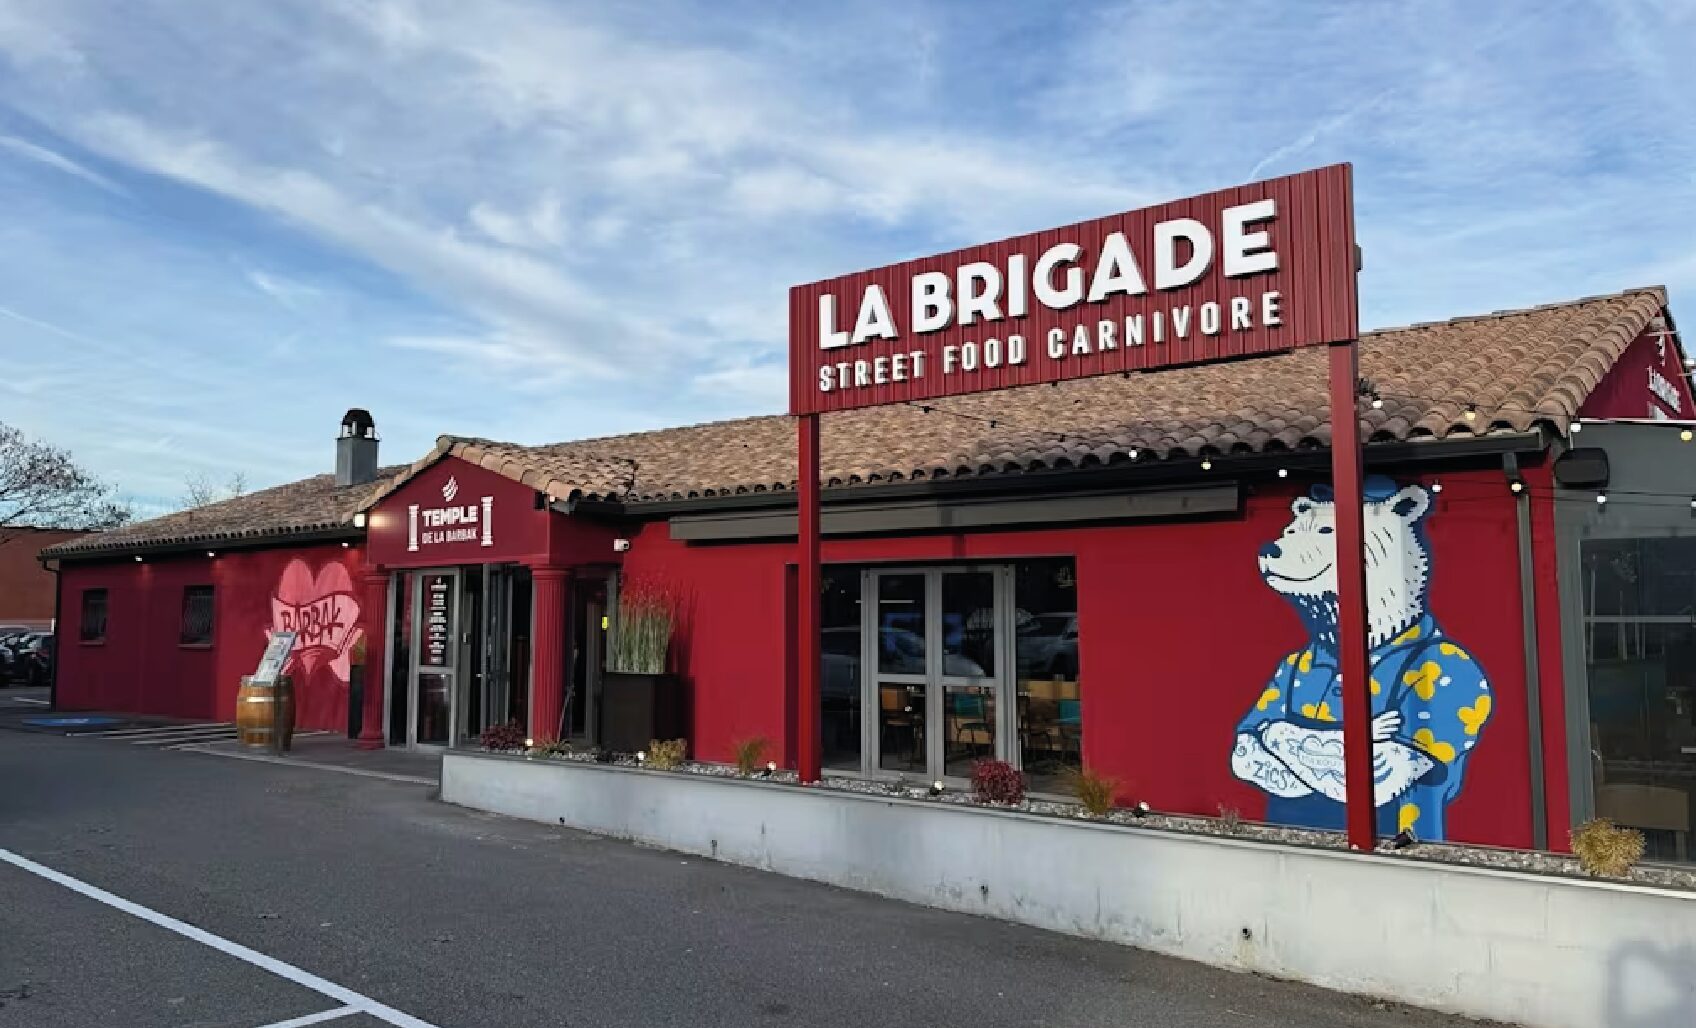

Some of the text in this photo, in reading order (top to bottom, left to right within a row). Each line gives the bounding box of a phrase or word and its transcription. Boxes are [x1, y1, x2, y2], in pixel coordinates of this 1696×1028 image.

[818, 199, 1279, 350] LA BRIGADE
[819, 291, 1282, 392] STREET FOOD CARNIVORE
[422, 506, 478, 527] TEMPLE
[422, 528, 476, 544] DE LA BARBAK
